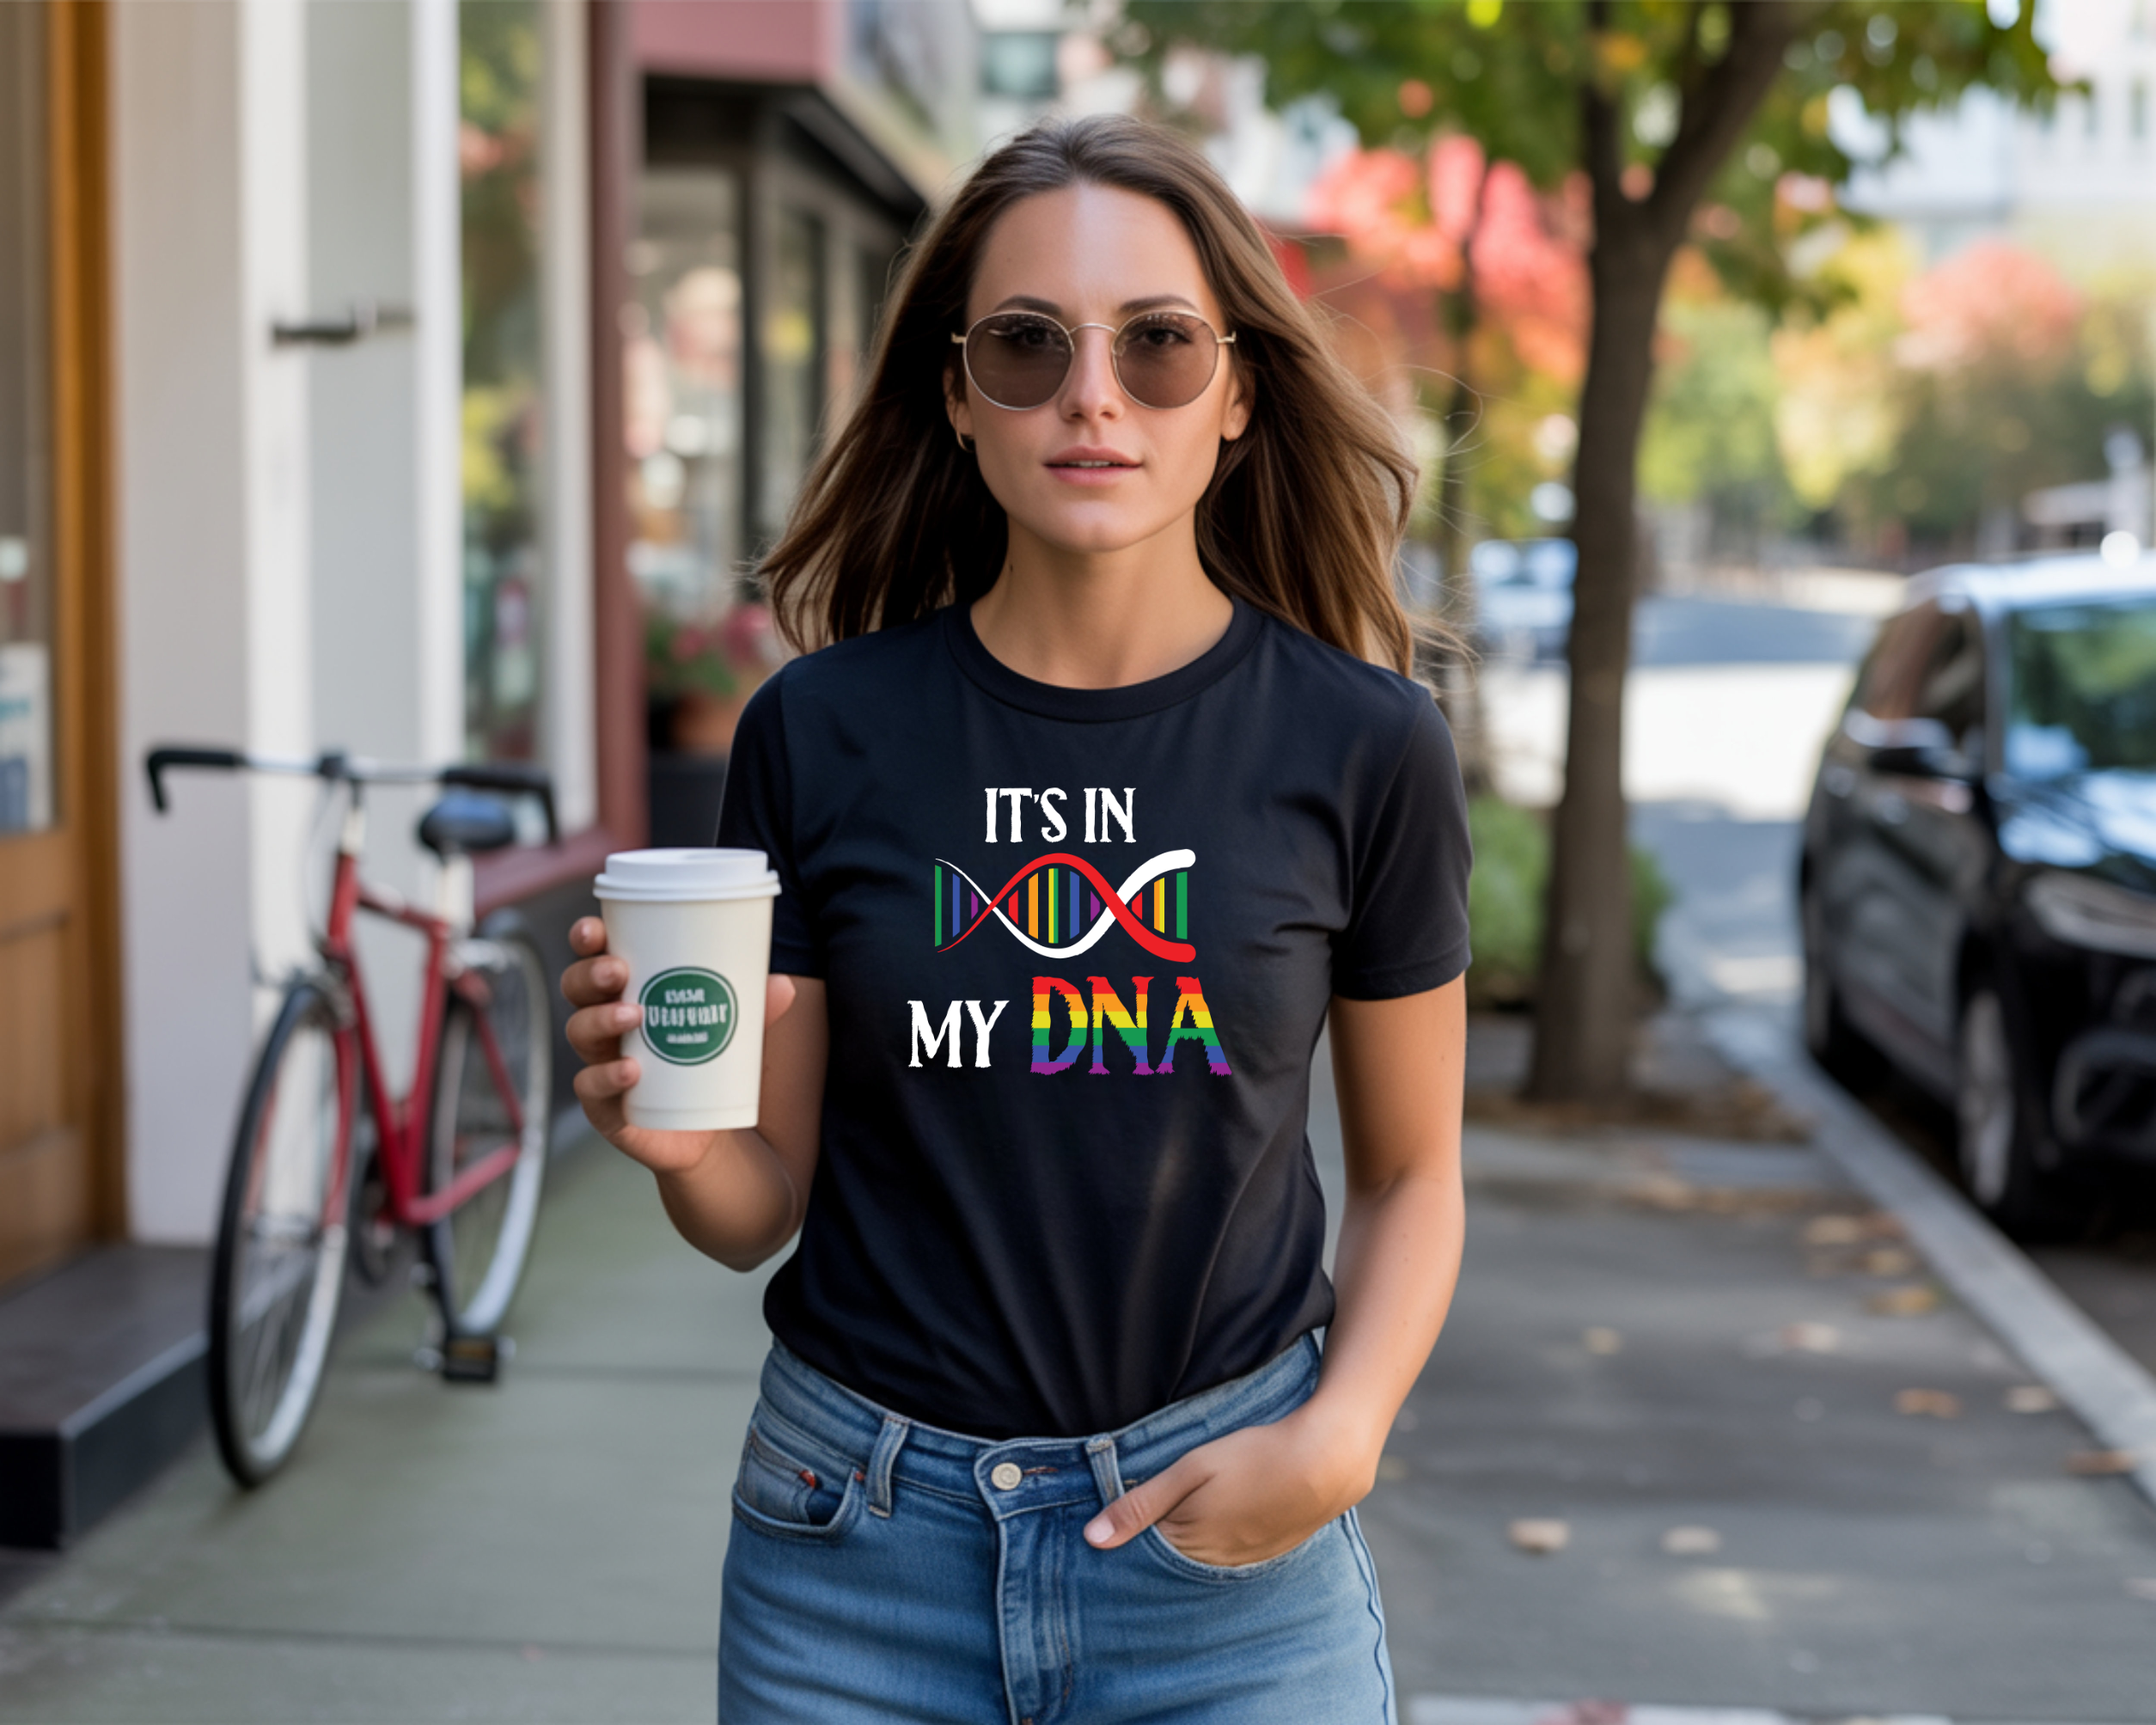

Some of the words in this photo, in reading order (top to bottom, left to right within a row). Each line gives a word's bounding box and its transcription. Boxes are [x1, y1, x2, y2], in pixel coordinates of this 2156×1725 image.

[984, 786, 1068, 844] IT'S
[1083, 786, 1137, 844] IN
[907, 1000, 1010, 1068] MY
[1029, 976, 1232, 1076] DNA
